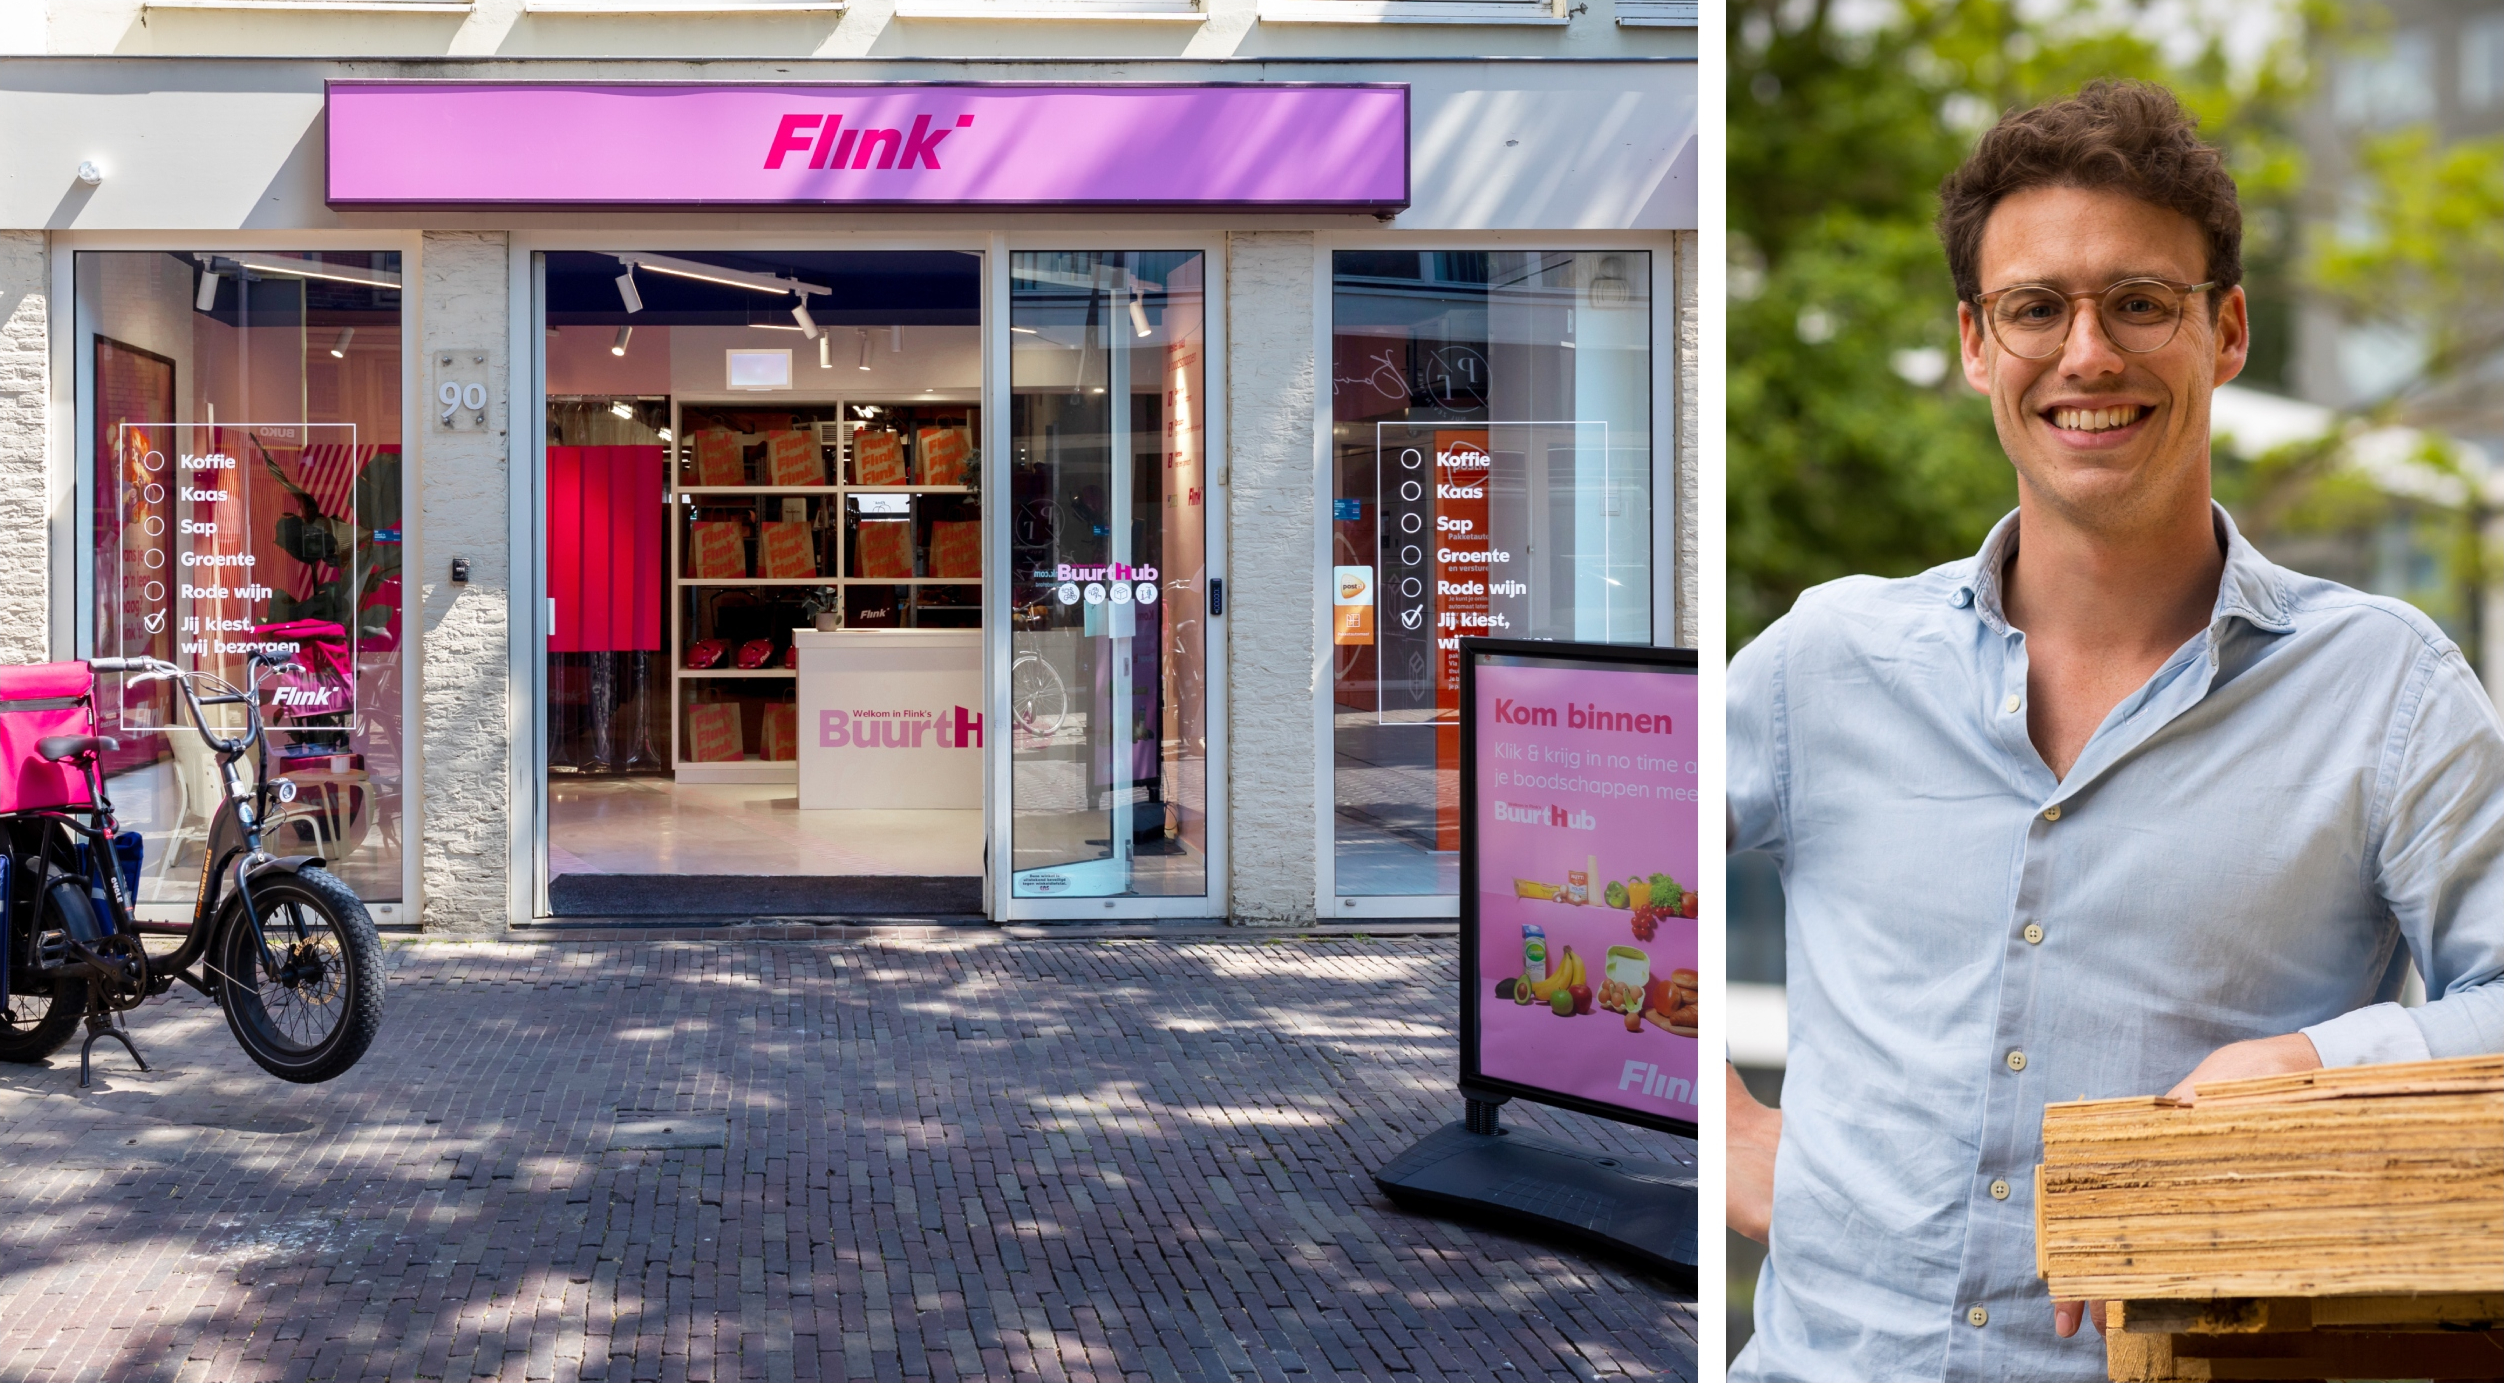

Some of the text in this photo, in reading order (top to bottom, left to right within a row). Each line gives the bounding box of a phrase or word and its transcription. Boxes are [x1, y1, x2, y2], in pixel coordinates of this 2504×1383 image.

[763, 114, 975, 170] Flink
[439, 381, 487, 418] 90
[181, 454, 236, 469] Koffie
[1437, 452, 1491, 467] Koffie
[181, 486, 228, 501] Kaas
[1437, 484, 1484, 499] Kaas
[181, 519, 217, 536] Sap
[1437, 516, 1473, 534] Sap
[181, 552, 255, 566] Groente
[1437, 548, 1511, 563] Groente
[1057, 562, 1159, 581] BuurtHub
[181, 583, 272, 602] Rode wijn
[1437, 580, 1526, 598] Rode wijn
[860, 608, 890, 620] Flink
[1437, 612, 1511, 630] Jij kiest,
[181, 617, 256, 634] Jij kiest,
[181, 640, 209, 657] wij
[1438, 634, 1464, 649] wi
[272, 687, 339, 705] Flink
[853, 709, 932, 718] Welkom in Flink's
[1495, 698, 1672, 734] Kom binnen
[1495, 742, 1522, 760] Klik
[1527, 744, 1539, 761] &
[1545, 746, 1581, 769] krijg
[1587, 749, 1601, 766] in
[1607, 755, 1631, 769] no
[1637, 754, 1679, 772] time
[1495, 769, 1509, 787] je
[1514, 770, 1650, 799] boodschappen
[1495, 800, 1596, 830] BuurtHub
[199, 872, 208, 901] POWER
[204, 848, 213, 872] BIKES
